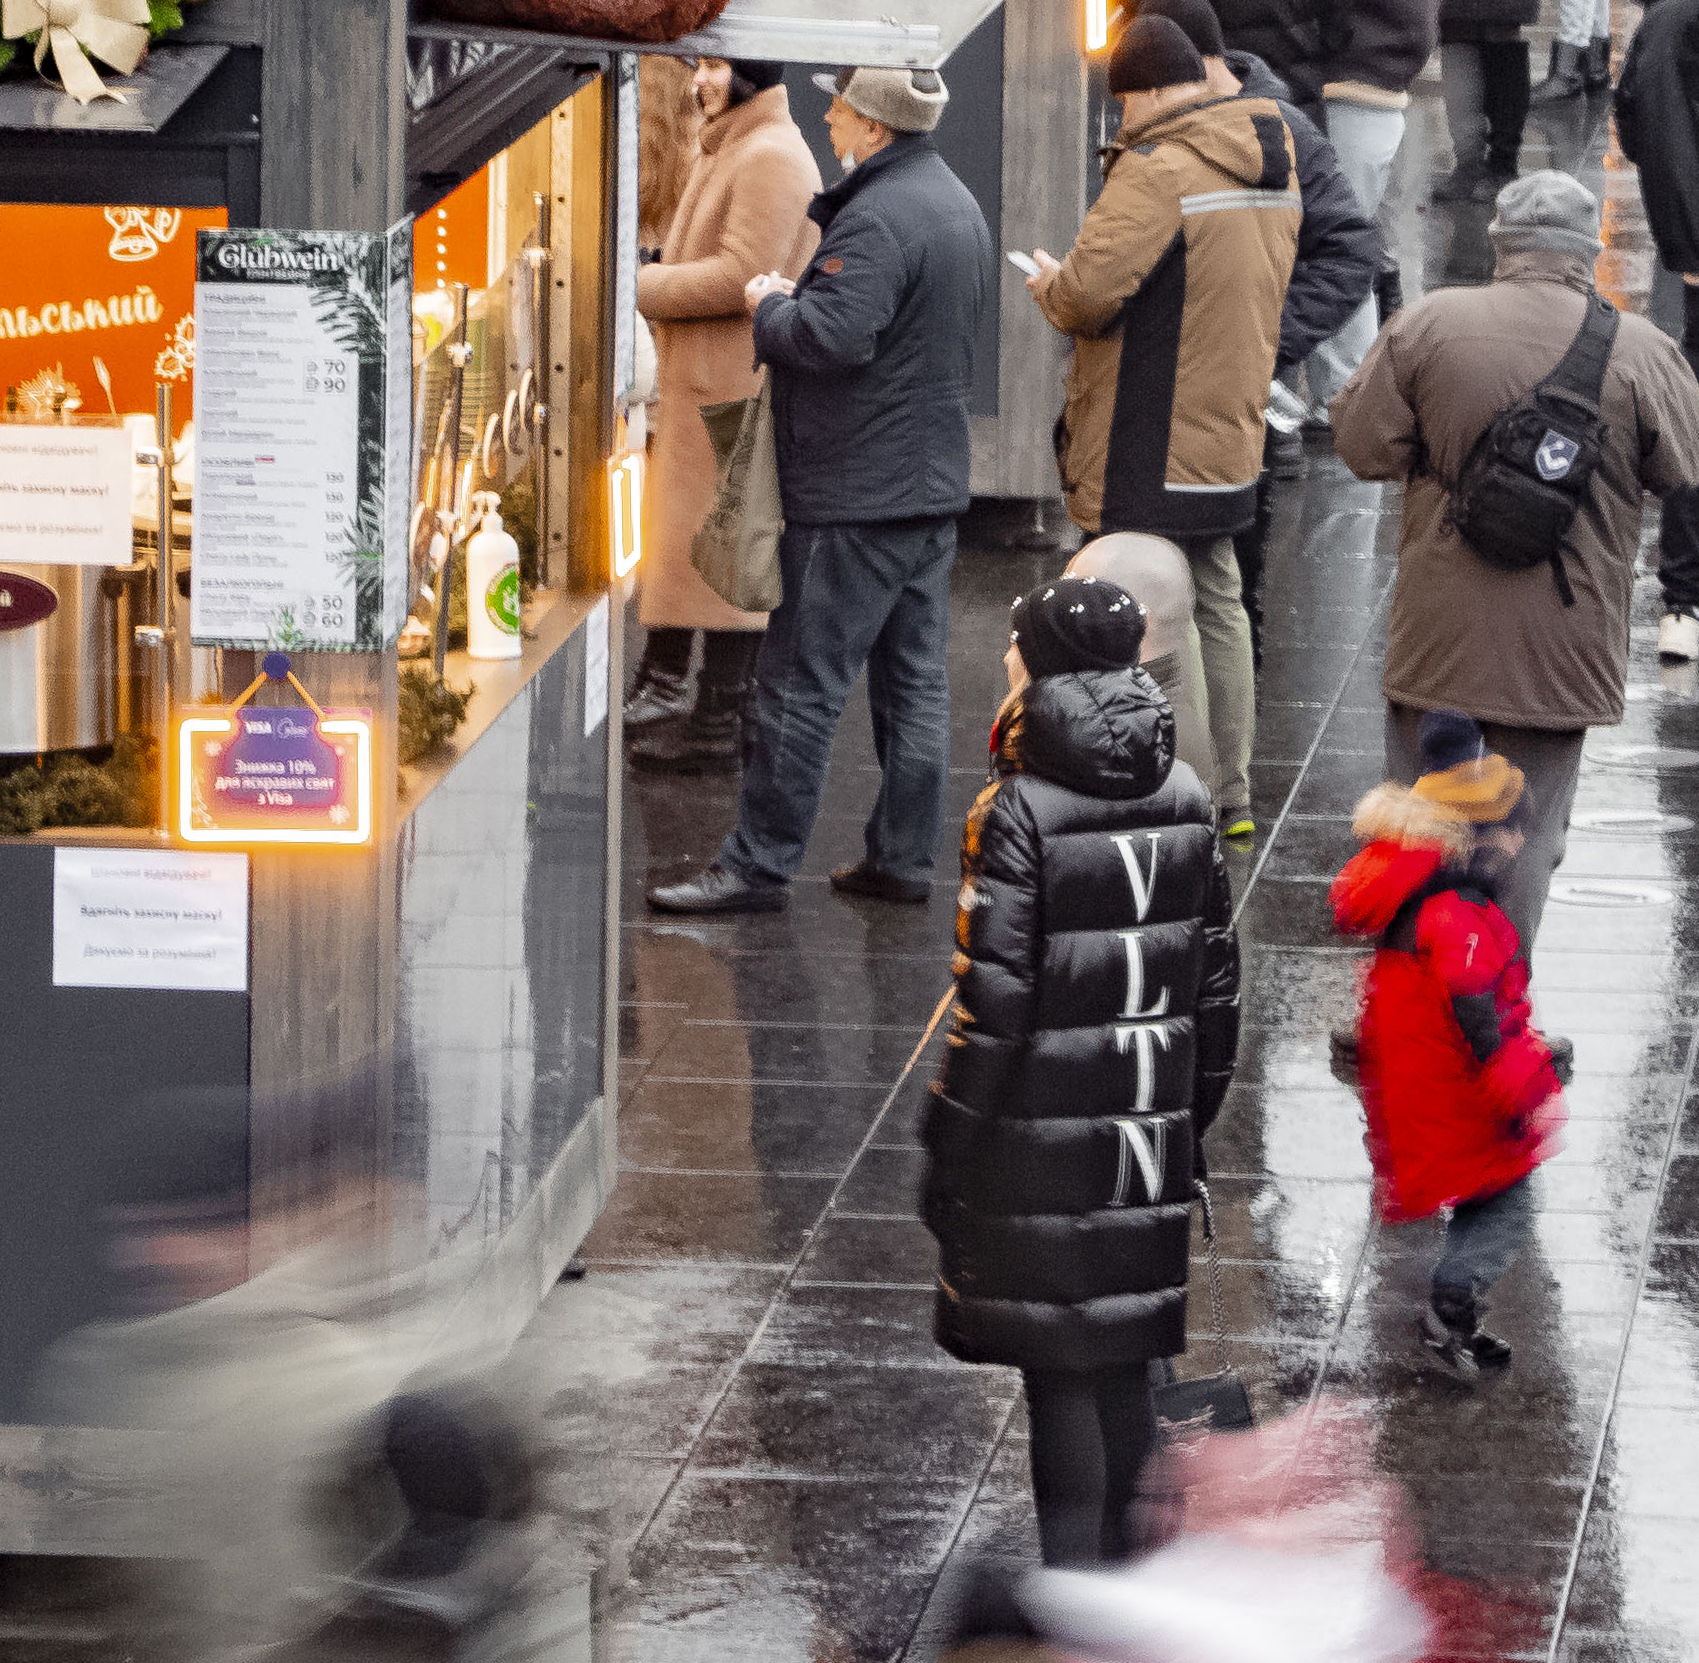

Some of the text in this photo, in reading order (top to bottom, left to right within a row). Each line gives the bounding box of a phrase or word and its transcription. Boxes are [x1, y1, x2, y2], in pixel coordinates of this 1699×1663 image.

[324, 358, 346, 375] 70
[324, 377, 346, 393] 90
[322, 594, 343, 610] 50
[322, 612, 343, 628] 60
[289, 759, 317, 775] 10%
[1108, 832, 1171, 1206] VLTN
